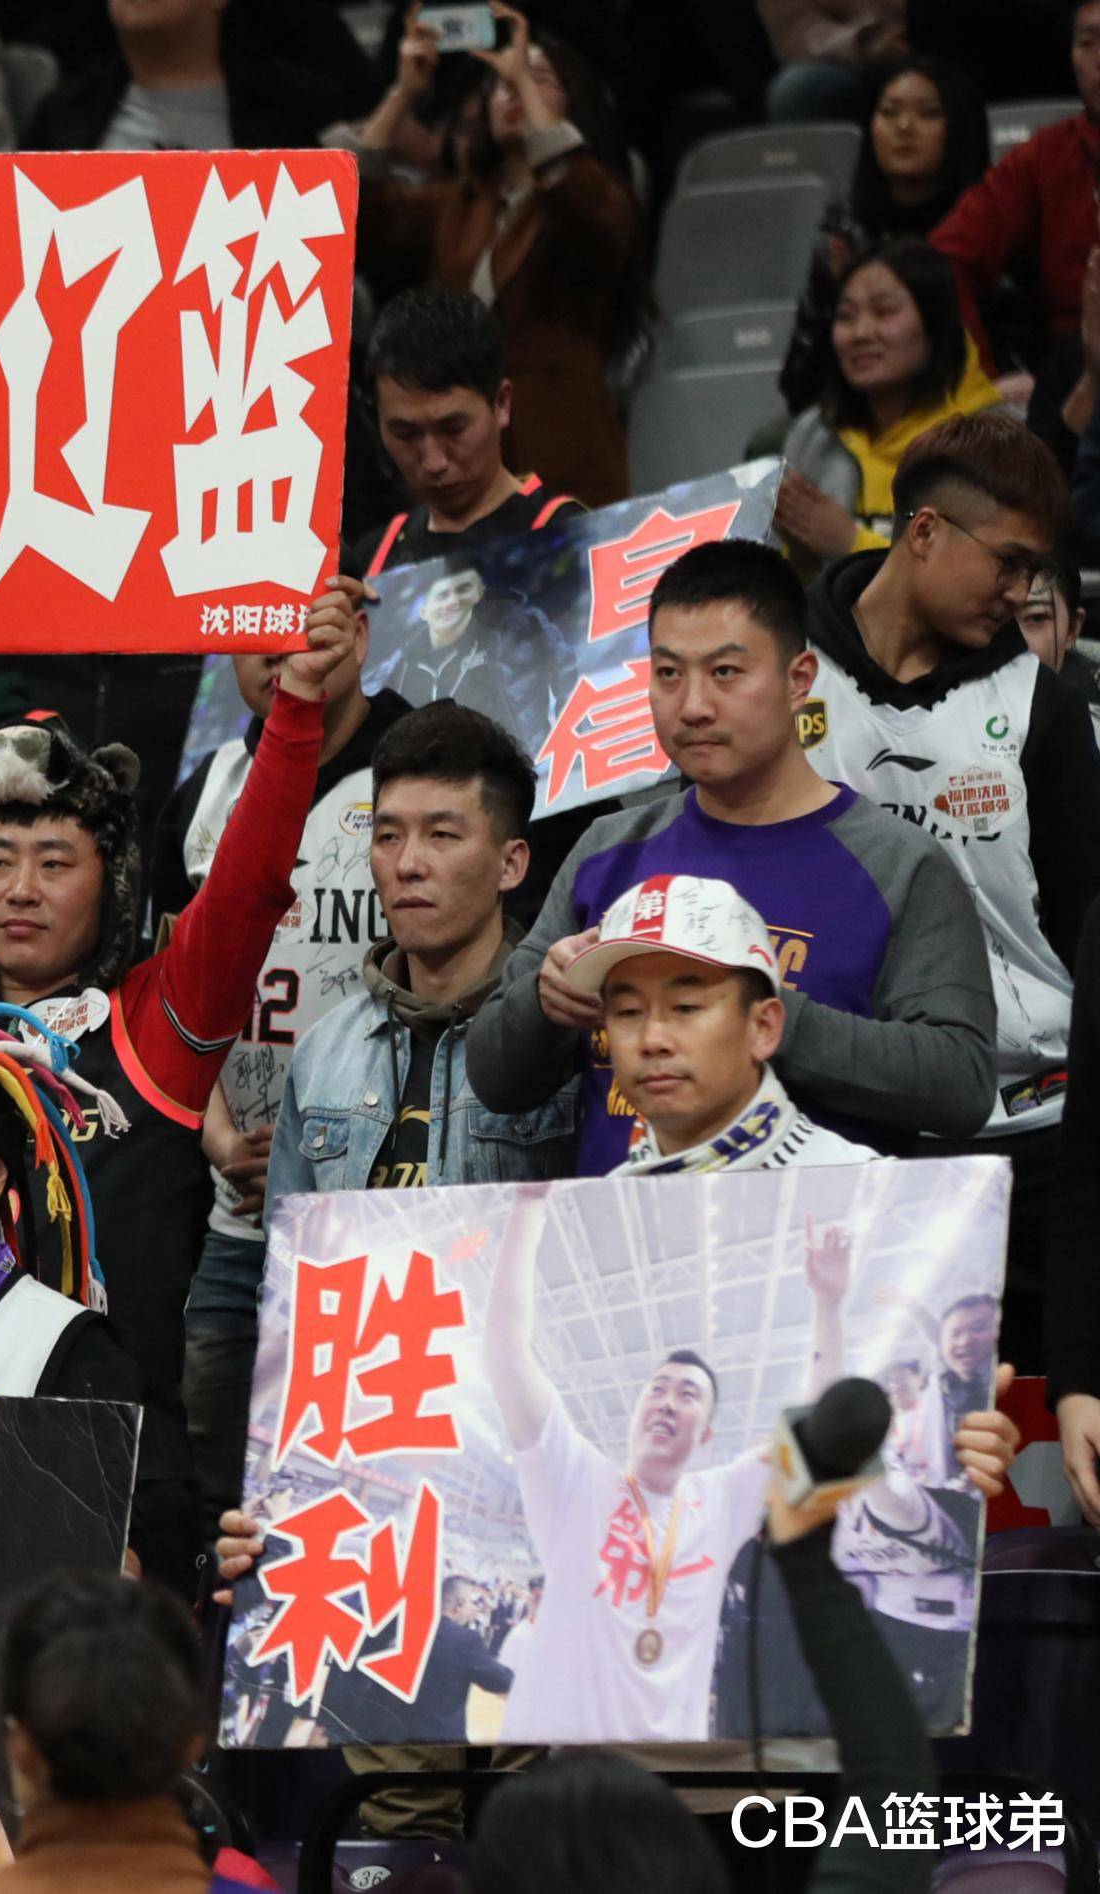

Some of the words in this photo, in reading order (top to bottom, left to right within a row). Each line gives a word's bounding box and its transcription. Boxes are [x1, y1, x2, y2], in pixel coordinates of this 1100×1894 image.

[795, 713, 825, 744] ps
[250, 1249, 466, 1704] 胜利
[359, 1871, 384, 1888] 36
